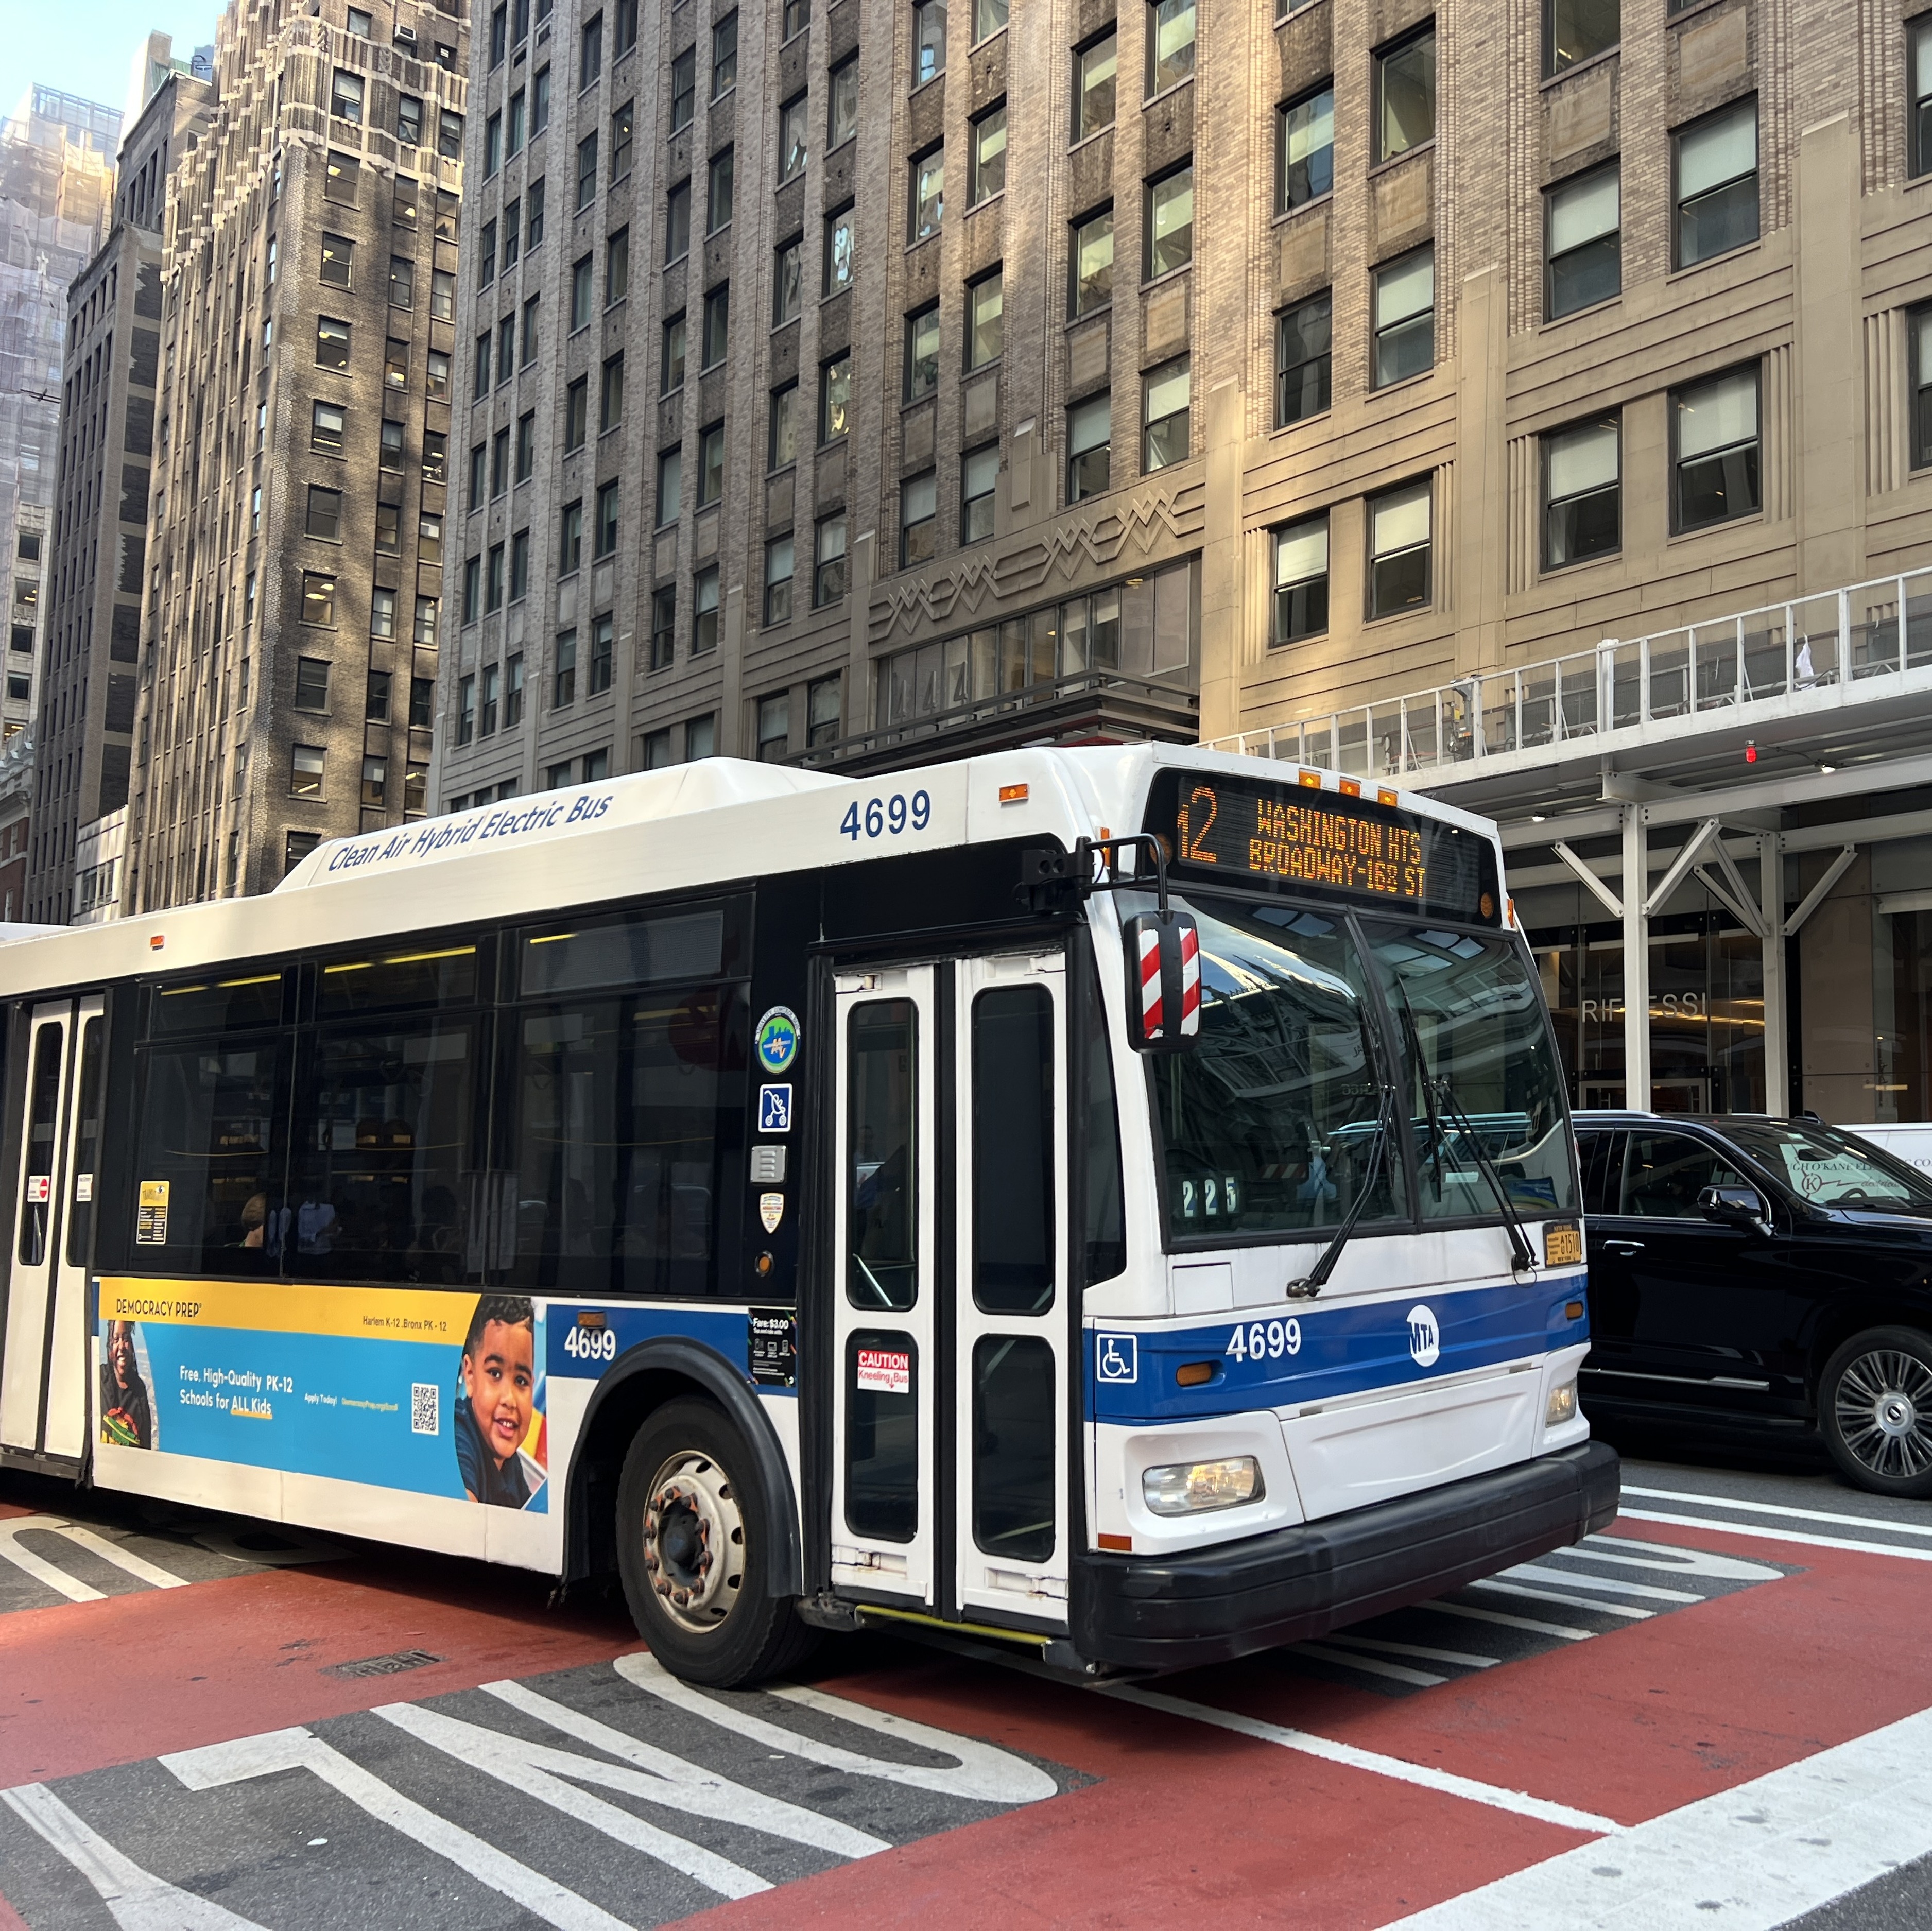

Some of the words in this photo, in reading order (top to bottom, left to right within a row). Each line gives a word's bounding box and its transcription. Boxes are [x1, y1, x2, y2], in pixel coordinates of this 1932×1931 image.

[840, 789, 930, 841] 4699
[329, 844, 380, 871] Clean
[377, 833, 412, 861] Air
[409, 816, 485, 858] Hybrid
[478, 801, 564, 839] Electric
[565, 796, 614, 823] Bus
[1257, 799, 1381, 857] WASHINGTON
[1388, 827, 1420, 864] HTS
[1249, 838, 1398, 892] BROADWAY-168
[1405, 866, 1426, 897] ST
[1582, 992, 1705, 1023] RIFESSI
[116, 1298, 174, 1317] DEMOCRACY
[363, 1315, 384, 1326] Harlem
[386, 1317, 400, 1328] K-12
[424, 1319, 434, 1331] PK
[439, 1321, 447, 1332] 12
[564, 1326, 616, 1361] 4699
[1225, 1318, 1302, 1363] 4699
[858, 1352, 908, 1370] CAUTION
[203, 1367, 262, 1393] High-Quality
[267, 1375, 293, 1393] PK-12
[858, 1370, 890, 1384] Kneeling
[894, 1372, 908, 1383] Bus
[180, 1389, 213, 1407] Schools
[216, 1392, 230, 1410] for
[232, 1395, 249, 1412] ALL
[251, 1397, 272, 1415] Kids
[305, 1392, 319, 1405] Apply
